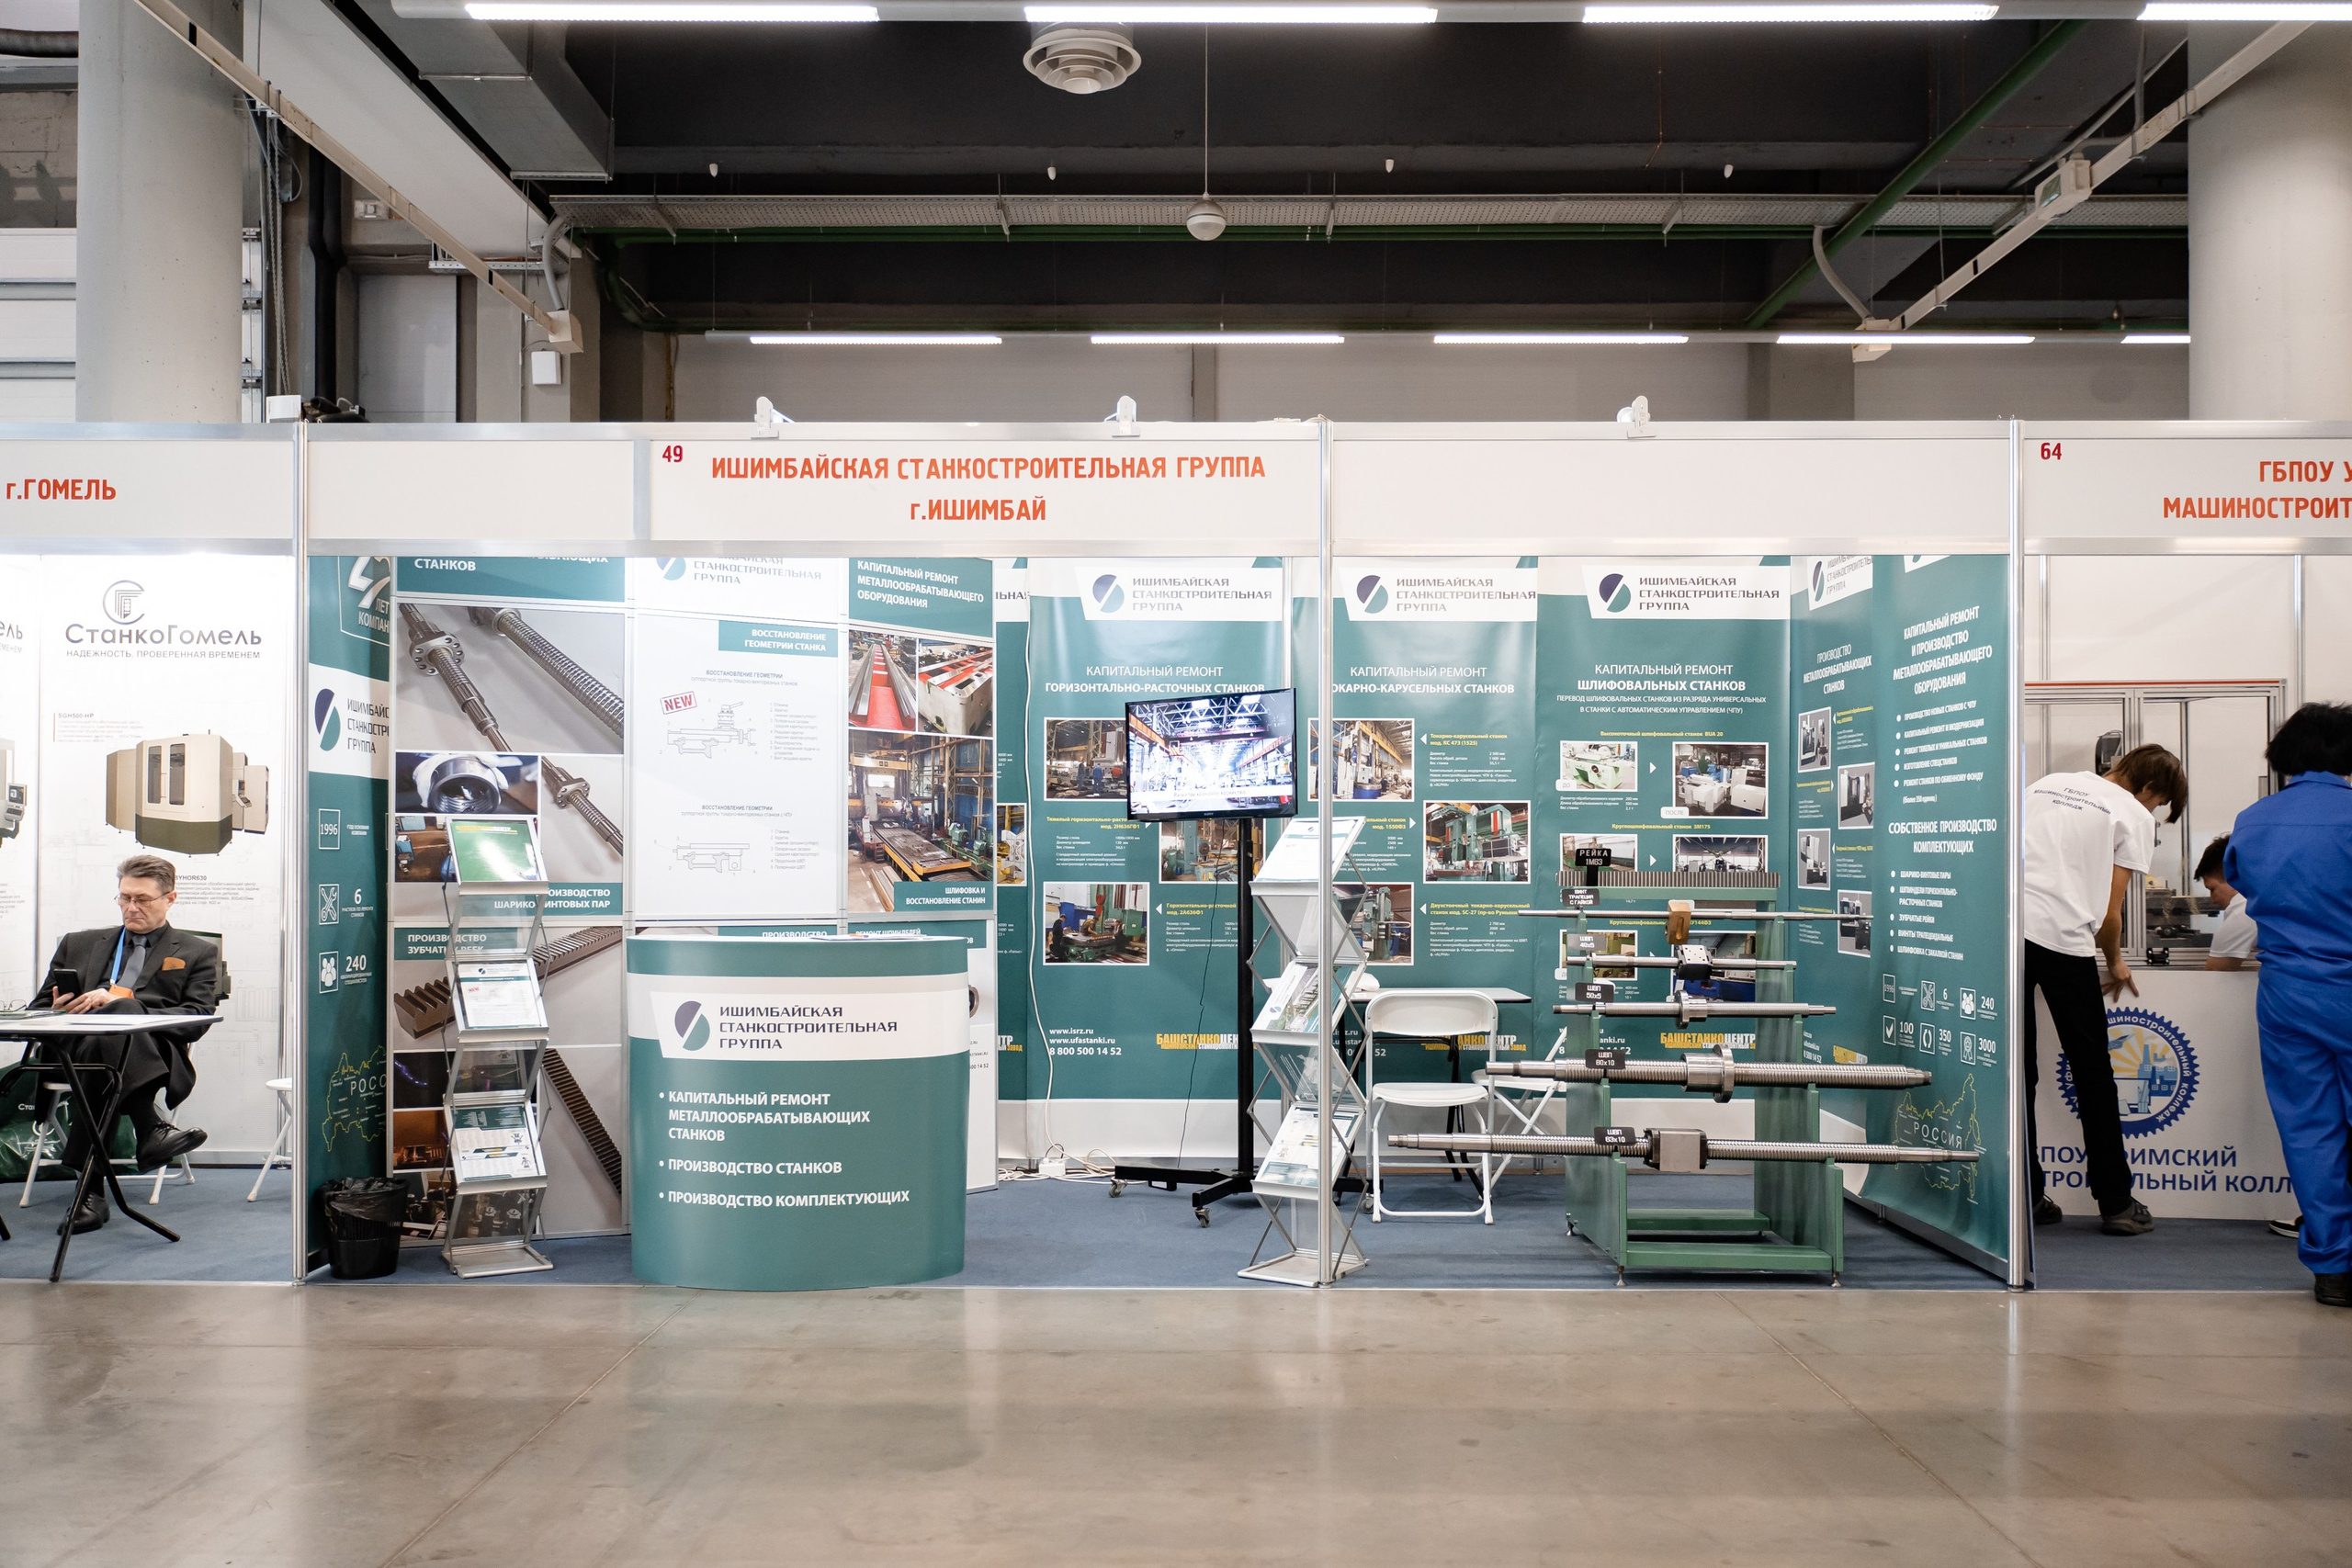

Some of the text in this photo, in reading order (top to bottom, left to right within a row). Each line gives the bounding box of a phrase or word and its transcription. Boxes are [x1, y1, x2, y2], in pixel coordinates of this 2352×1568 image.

[662, 446, 683, 463] 49
[2040, 442, 2063, 461] 64
[711, 452, 1266, 479] ИШИМБАЙСКАЯ СТАНКОСТРОИТЕЛЬНАЯ ГРУППА
[2259, 461, 2335, 483] ГБПОУ
[6, 478, 117, 502] г.ГОМЕЛЬ
[910, 494, 1046, 522] г.ИШИМБАЙ
[413, 558, 477, 571] СТАНКОВ
[694, 560, 822, 581] СТАНКОСТРОИТЕЛЬНАЯ
[694, 572, 741, 584] ГРУППА
[857, 559, 959, 585] КАПИТАЛЬНЫЙ РЕМОНТ
[1133, 576, 1229, 587] ИШИМБАЙСКАЯ
[1396, 577, 1493, 587] ИШИМБАЙСКАЯ
[1639, 576, 1736, 586] ИШИМБАЙСКАЯ
[857, 574, 984, 604] МЕТАЛЛООБРАБАТЫВАЮЩЕГО
[1396, 590, 1536, 600] СТАНКОСТРОИТЕЛЬНАЯ
[1639, 589, 1780, 599] СТАНКОСТРОИТЕЛЬНАЯ
[1826, 581, 1847, 596] ГРУППА
[856, 589, 928, 609] ОБОРУДОВАНИЯ
[1133, 591, 1272, 600] СТАНКОСТРОИТЕЛЬНАЯ
[1133, 603, 1182, 612] ГРУППА
[1396, 603, 1447, 612] ГРУППА
[1639, 602, 1690, 611] ГРУППА
[1904, 605, 1980, 640] КАПИТАЛЬНЫЙ РЕМОНТ
[65, 623, 263, 646] СтанкоГомель
[752, 628, 827, 641] ВОССТАНОВЛЕНИЕ
[744, 639, 827, 652] ГЕОМЕТРИИ СТАНКА
[1911, 629, 1969, 657] И ПРОИЗВОДСТВО
[137, 650, 206, 659] ПРОВЕРЕННАЯ
[209, 650, 261, 660] ВРЕМЕНЕМ
[1816, 644, 1852, 663] ПРОИЗВОДСТВО
[1595, 663, 1734, 675] КАПИТАЛЬНЫЙ РЕМОНТ
[1804, 655, 1872, 683] МЕТАЛЛООБРАБАТЫВАЮЩИХ
[1893, 645, 1993, 681] МЕТАЛЛООБРАБАТЫВАЮЩЕГО
[706, 670, 753, 678] ВОССТАНОВЛЕНИЕ
[1086, 664, 1224, 677] КАПИТАЛЬНЫЙ РЕМОНТ
[1350, 664, 1487, 677] КАПИТАЛЬНЫЙ РЕМОНТ
[1045, 682, 1265, 694] ГОРИЗОНТАЛЬНО-РАСТОЧНЫХ СТАНКОВ
[1332, 683, 1515, 694] ОКАРНО-КАРУСЕЛЬНЫХ СТАНКОВ
[1577, 680, 1746, 691] ШЛИФОВАЛЬНЫХ СТАНКОВ
[1823, 679, 1845, 694] СТАНКОВ
[1914, 671, 1966, 695] ОБОРУДОВАНИЯ
[662, 692, 695, 713] NEW
[1556, 694, 1585, 704] ПЕРЕВОД
[1586, 694, 1642, 703] ШЛИФОВАЛЬНЫХ
[1643, 695, 1672, 704] СТАНКОВ
[1683, 695, 1712, 704] РАЗРЯДА
[1712, 695, 1767, 704] УНИВЕРСАЛЬНЫХ
[347, 737, 376, 753] ГРУППА
[2064, 787, 2090, 797] ГБПОУ
[2052, 799, 2084, 811] колледж
[320, 823, 338, 836] 1996
[1888, 818, 1997, 835] СОБСТВЕННОЕ ПРОИЗВОДСТВО
[1913, 840, 1974, 855] КОМПЛЕКТУЮЩИХ
[354, 888, 362, 905] 6
[548, 888, 611, 898] ОИЗВОДСТВО
[944, 886, 979, 895] ШЛИФОВКА
[493, 899, 611, 909] ШАРИКО-ИНТОВЫХ ПАР
[963, 897, 986, 905] СТАНИН
[345, 954, 367, 973] 240
[1942, 987, 1948, 1000] 6
[1981, 996, 1995, 1010] 240
[719, 1004, 842, 1017] ИШИМБАЙСКАЯ
[719, 1021, 898, 1033] СТАНКОСТРОИТЕЛЬНАЯ
[1899, 1021, 1914, 1034] 100
[1049, 1036, 1115, 1044] www.ufastanki.ru
[1660, 1032, 1756, 1044] БАШСТАНКОЦЕНТР
[1939, 1028, 1951, 1043] 350
[719, 1038, 783, 1049] ГРУППА
[1978, 1037, 1996, 1054] 3000
[2108, 1015, 2192, 1077] шиностроительный
[1049, 1047, 1122, 1055] 8 800 500 14 52
[1374, 1048, 1386, 1056] 52
[669, 1090, 831, 1105] КАПИТАЛЬНЫЙ РЕМОНТ
[669, 1109, 870, 1125] МЕТАЛЛООБРАБАТЫВАЮЩИХ
[669, 1127, 726, 1142] СТАНКОВ
[1914, 1121, 1962, 1150] РОССИЯ
[2034, 1145, 2237, 1168] ПОУ ИМСКИЙ
[668, 1158, 842, 1176] ПРОИЗВОДСТВО СТАНКОВ
[668, 1190, 910, 1208] ПРОИЗВОДСТВО КОМПЛЕКТУЮЩИХ
